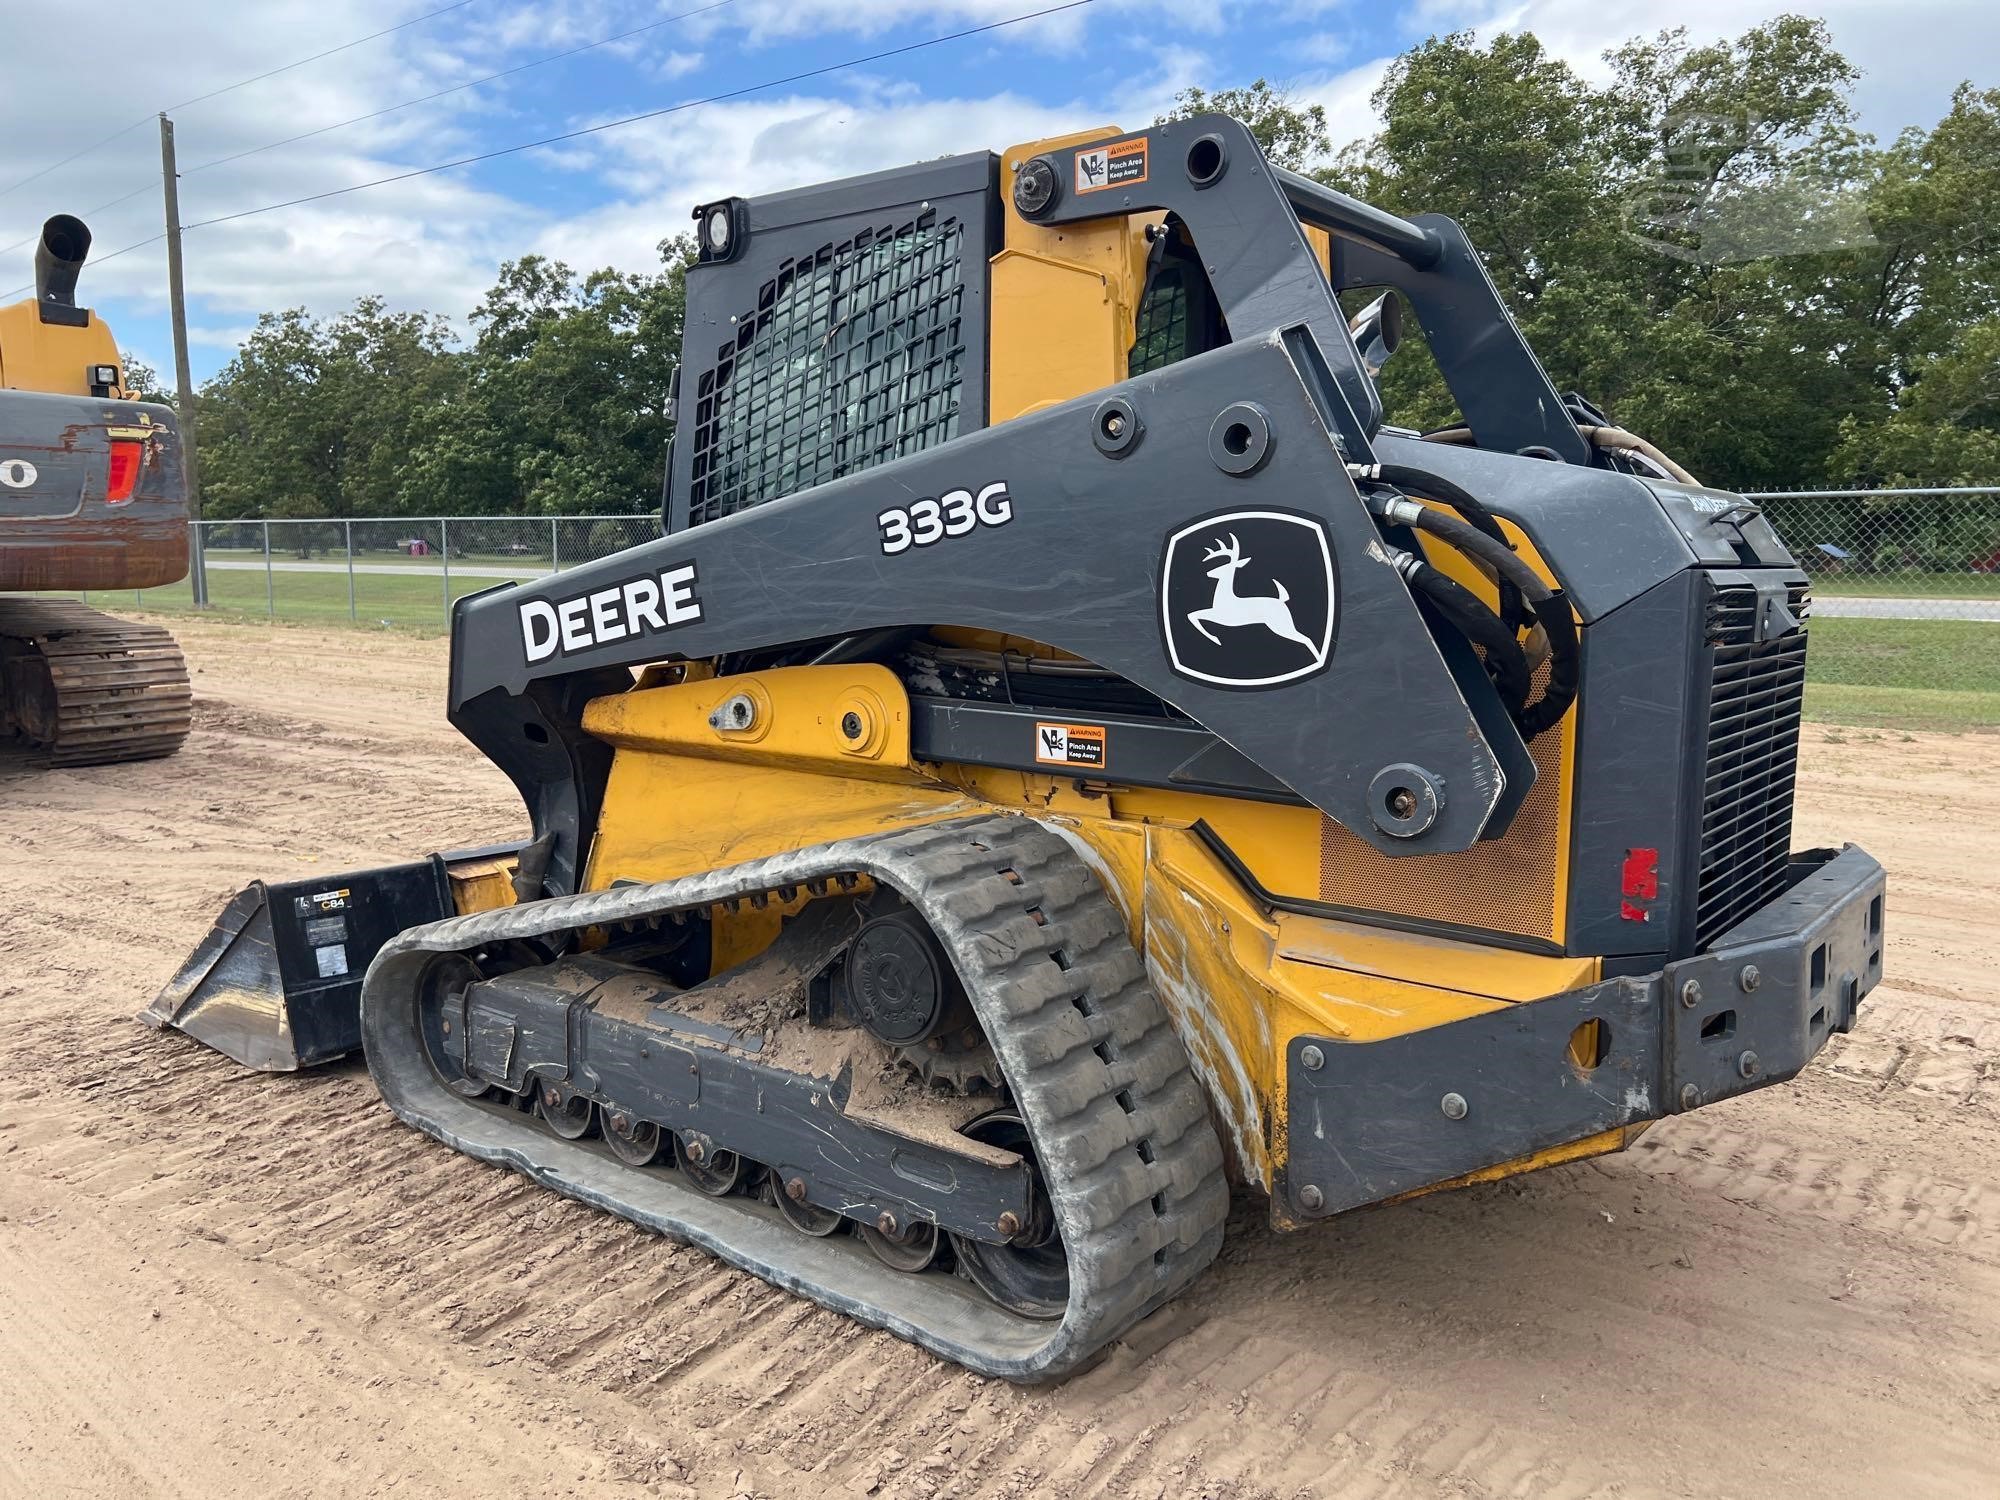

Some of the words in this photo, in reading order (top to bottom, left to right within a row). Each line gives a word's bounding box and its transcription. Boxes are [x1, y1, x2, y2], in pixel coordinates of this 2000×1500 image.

[1117, 143, 1144, 153] WARNING
[1109, 162, 1127, 171] Pinch
[1128, 158, 1143, 167] Area
[1109, 171, 1123, 179] Keep
[1123, 168, 1138, 177] Away
[879, 481, 1013, 554] 333G
[520, 565, 701, 662] DEERE
[1075, 729, 1102, 737] WARNING
[1069, 742, 1086, 751] Pinch
[1086, 744, 1101, 752] Area
[1069, 751, 1082, 759] Keep
[1082, 752, 1096, 760] Away
[321, 898, 345, 909] C84
